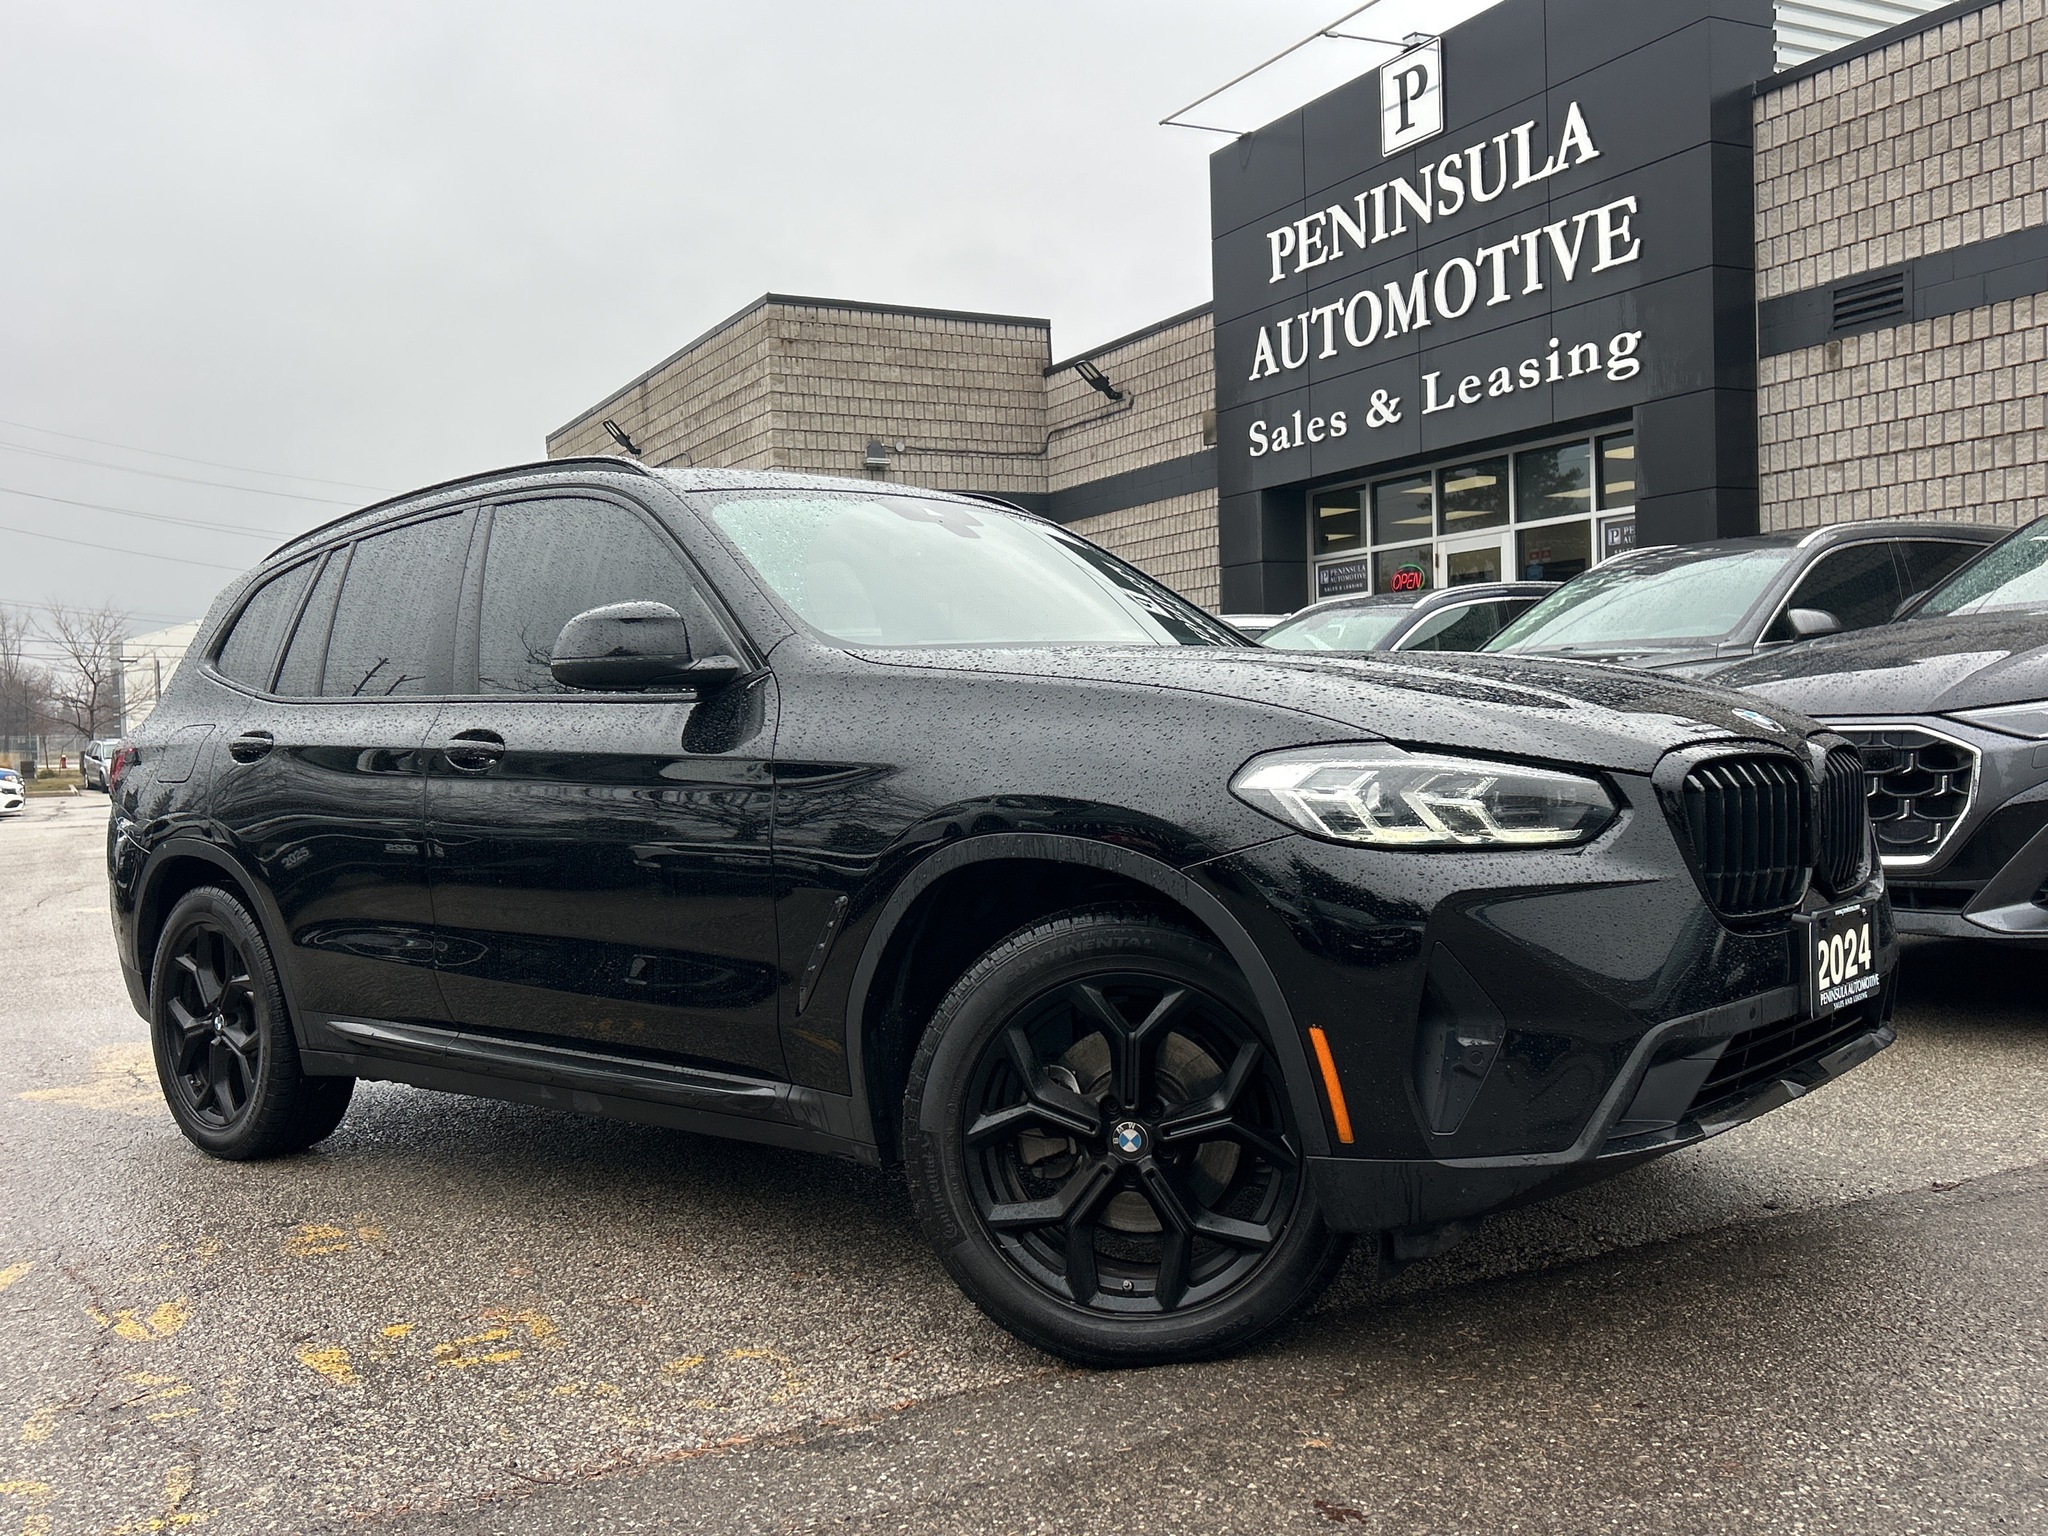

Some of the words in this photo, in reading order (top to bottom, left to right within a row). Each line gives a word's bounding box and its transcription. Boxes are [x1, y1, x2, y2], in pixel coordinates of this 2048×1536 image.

[1392, 63, 1428, 135] P
[1267, 101, 1600, 284] PENINSULA
[1249, 195, 1641, 380] AUTOMOTIVE
[1249, 410, 1348, 457] Sales
[1365, 388, 1402, 428] &
[1421, 330, 1642, 415] Leasing
[1611, 529, 1619, 544] P
[1330, 564, 1366, 576] PENINSULA
[1330, 573, 1366, 583] AUTOMOTIVE
[1393, 571, 1422, 590] OPEN
[1005, 936, 1154, 983] CONTINENTAL
[1818, 923, 1871, 991] 2024
[1820, 984, 1848, 1006] PENINSULA
[1848, 974, 1880, 995] AUTOMOTIVE
[1113, 1122, 1136, 1145] BMW
